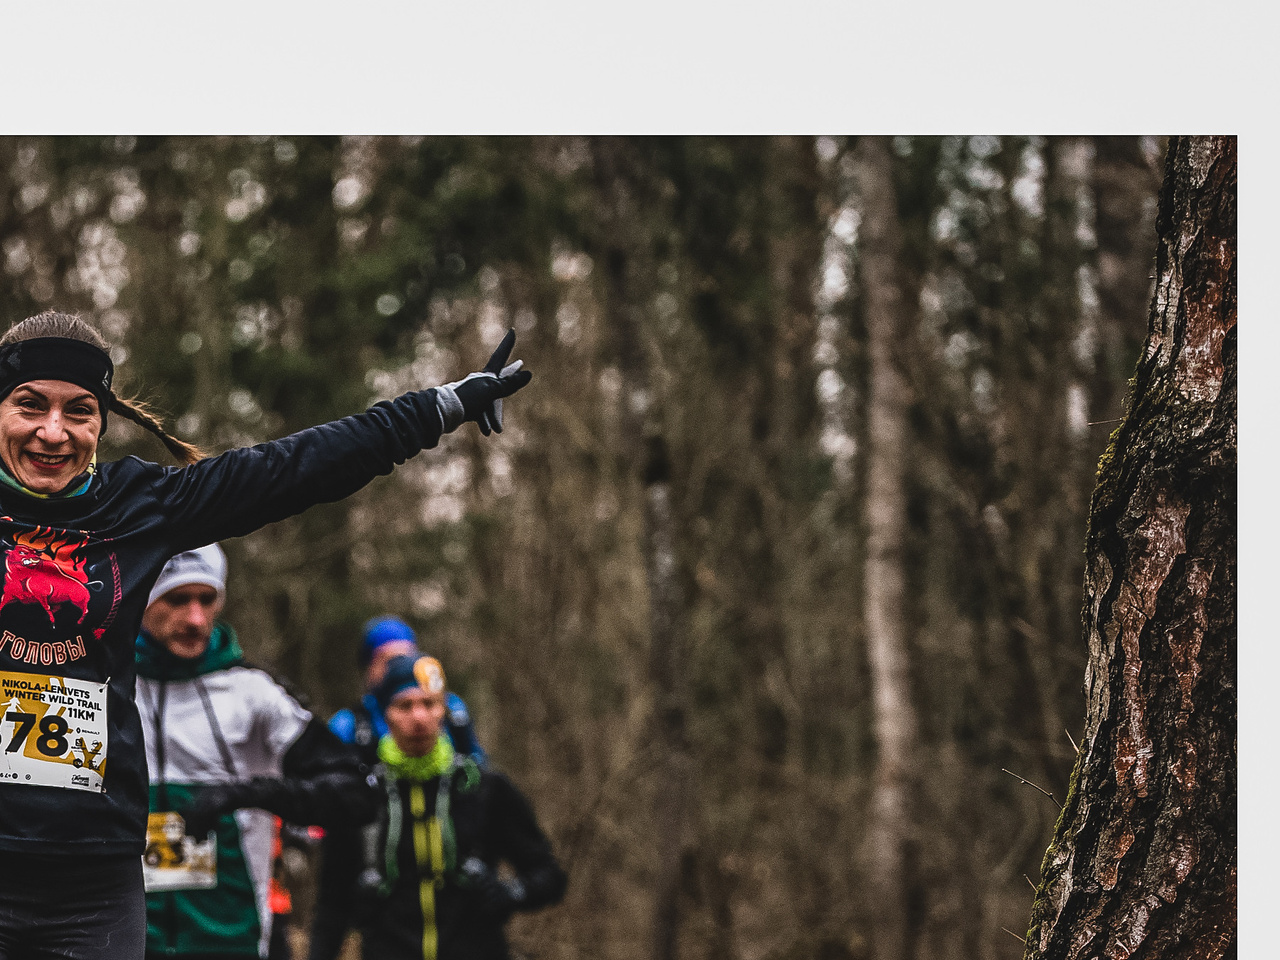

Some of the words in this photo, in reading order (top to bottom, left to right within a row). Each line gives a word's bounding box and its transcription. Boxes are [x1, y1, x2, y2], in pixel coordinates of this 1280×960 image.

[2, 679, 90, 699] NIKOLA-LENIVETS
[4, 689, 45, 701] WINTER
[48, 694, 74, 705] WILD
[76, 698, 102, 711] TRAIL
[68, 707, 95, 721] 11KM
